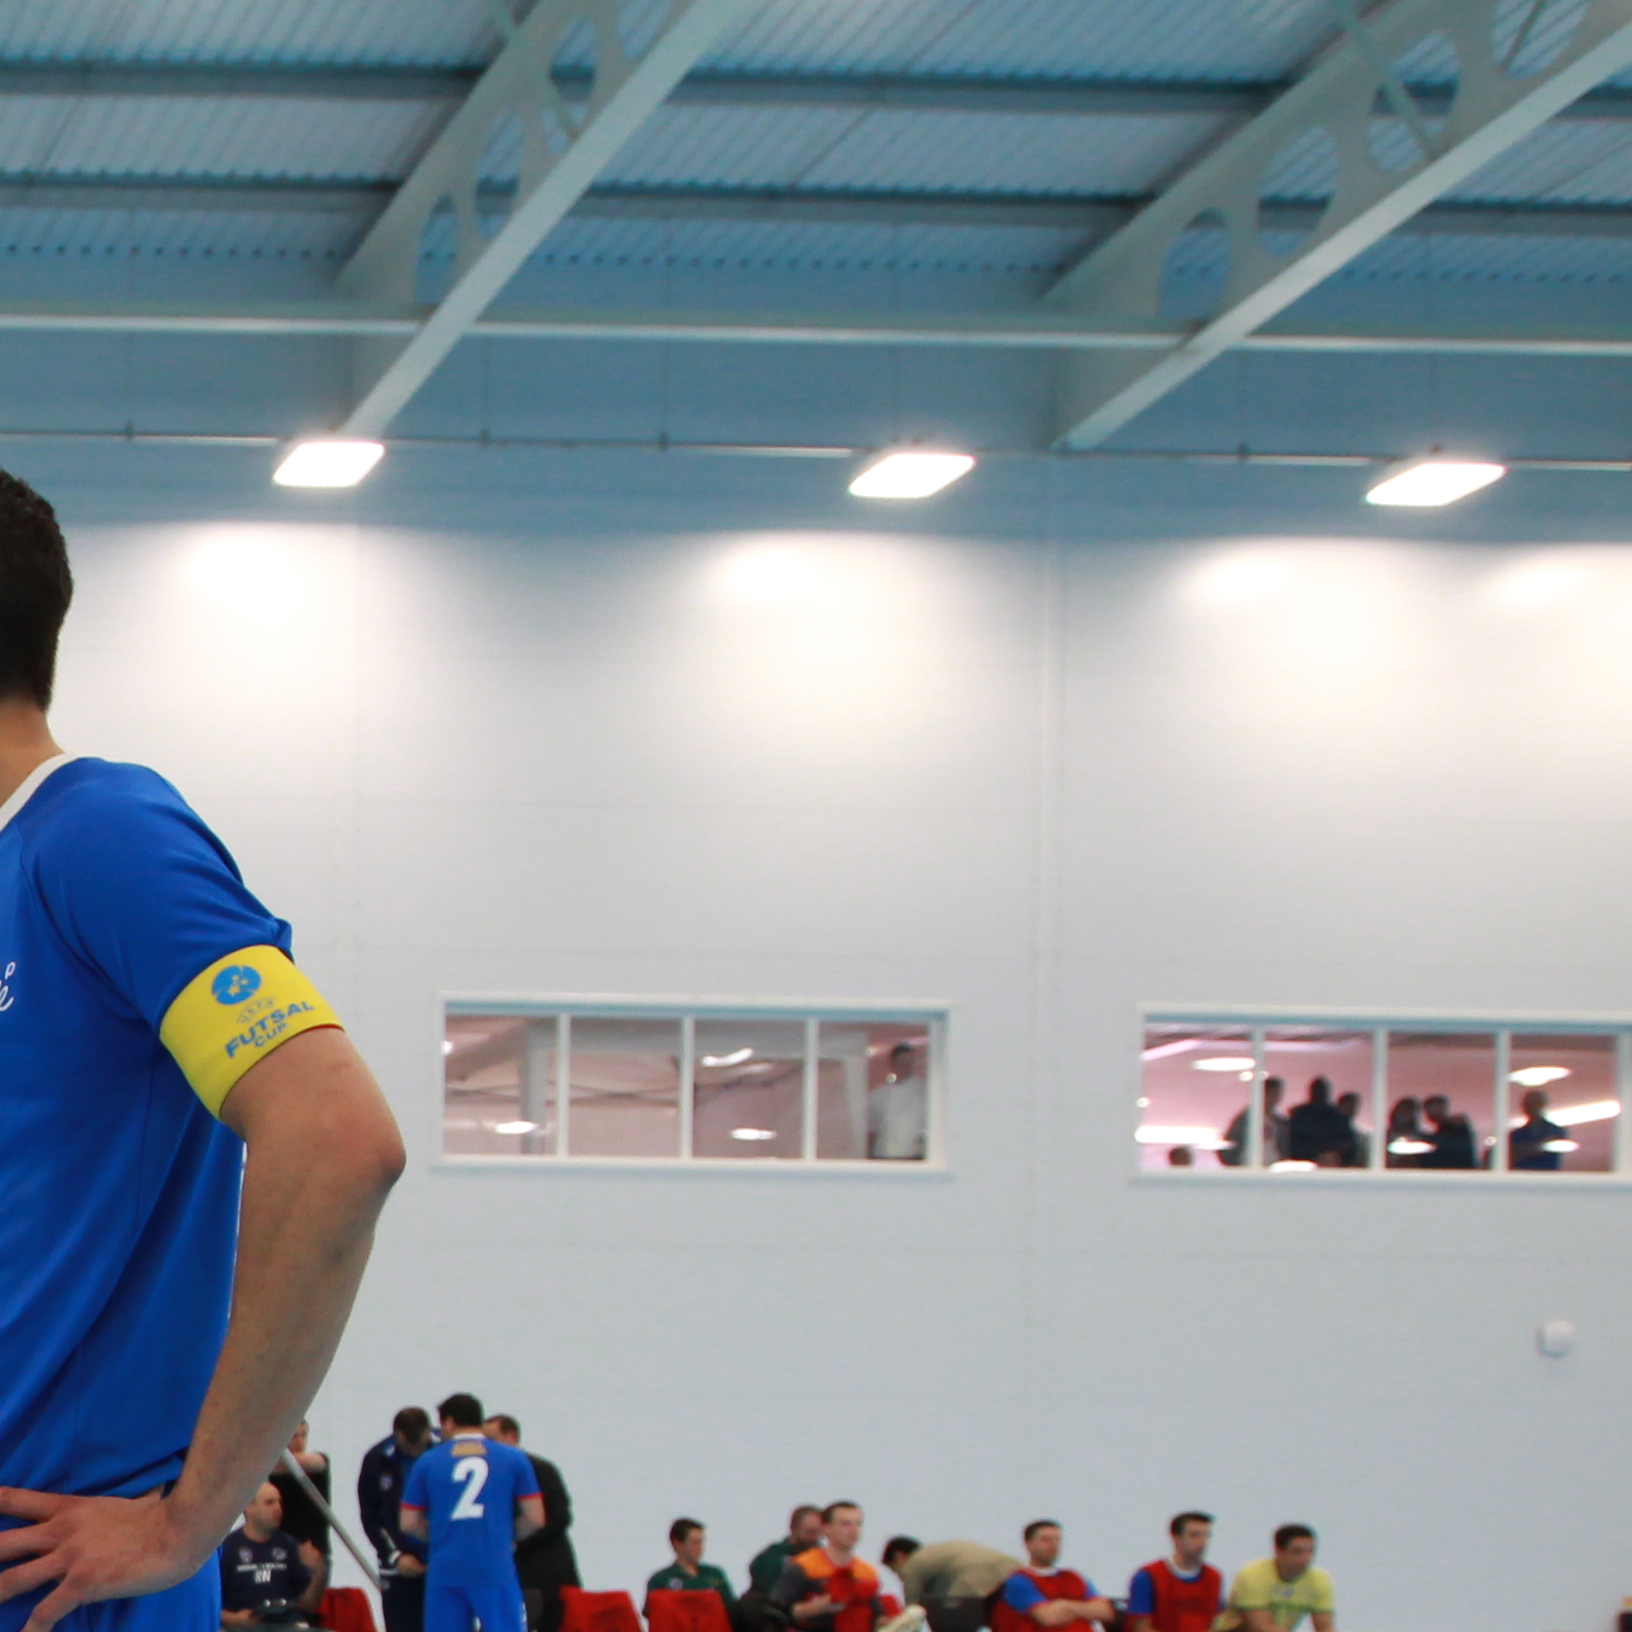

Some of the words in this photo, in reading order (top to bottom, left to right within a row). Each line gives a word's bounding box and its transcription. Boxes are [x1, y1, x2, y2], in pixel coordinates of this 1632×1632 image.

[225, 1001, 314, 1058] FUTSAL
[254, 1022, 287, 1047] CUP
[451, 1456, 489, 1520] 2
